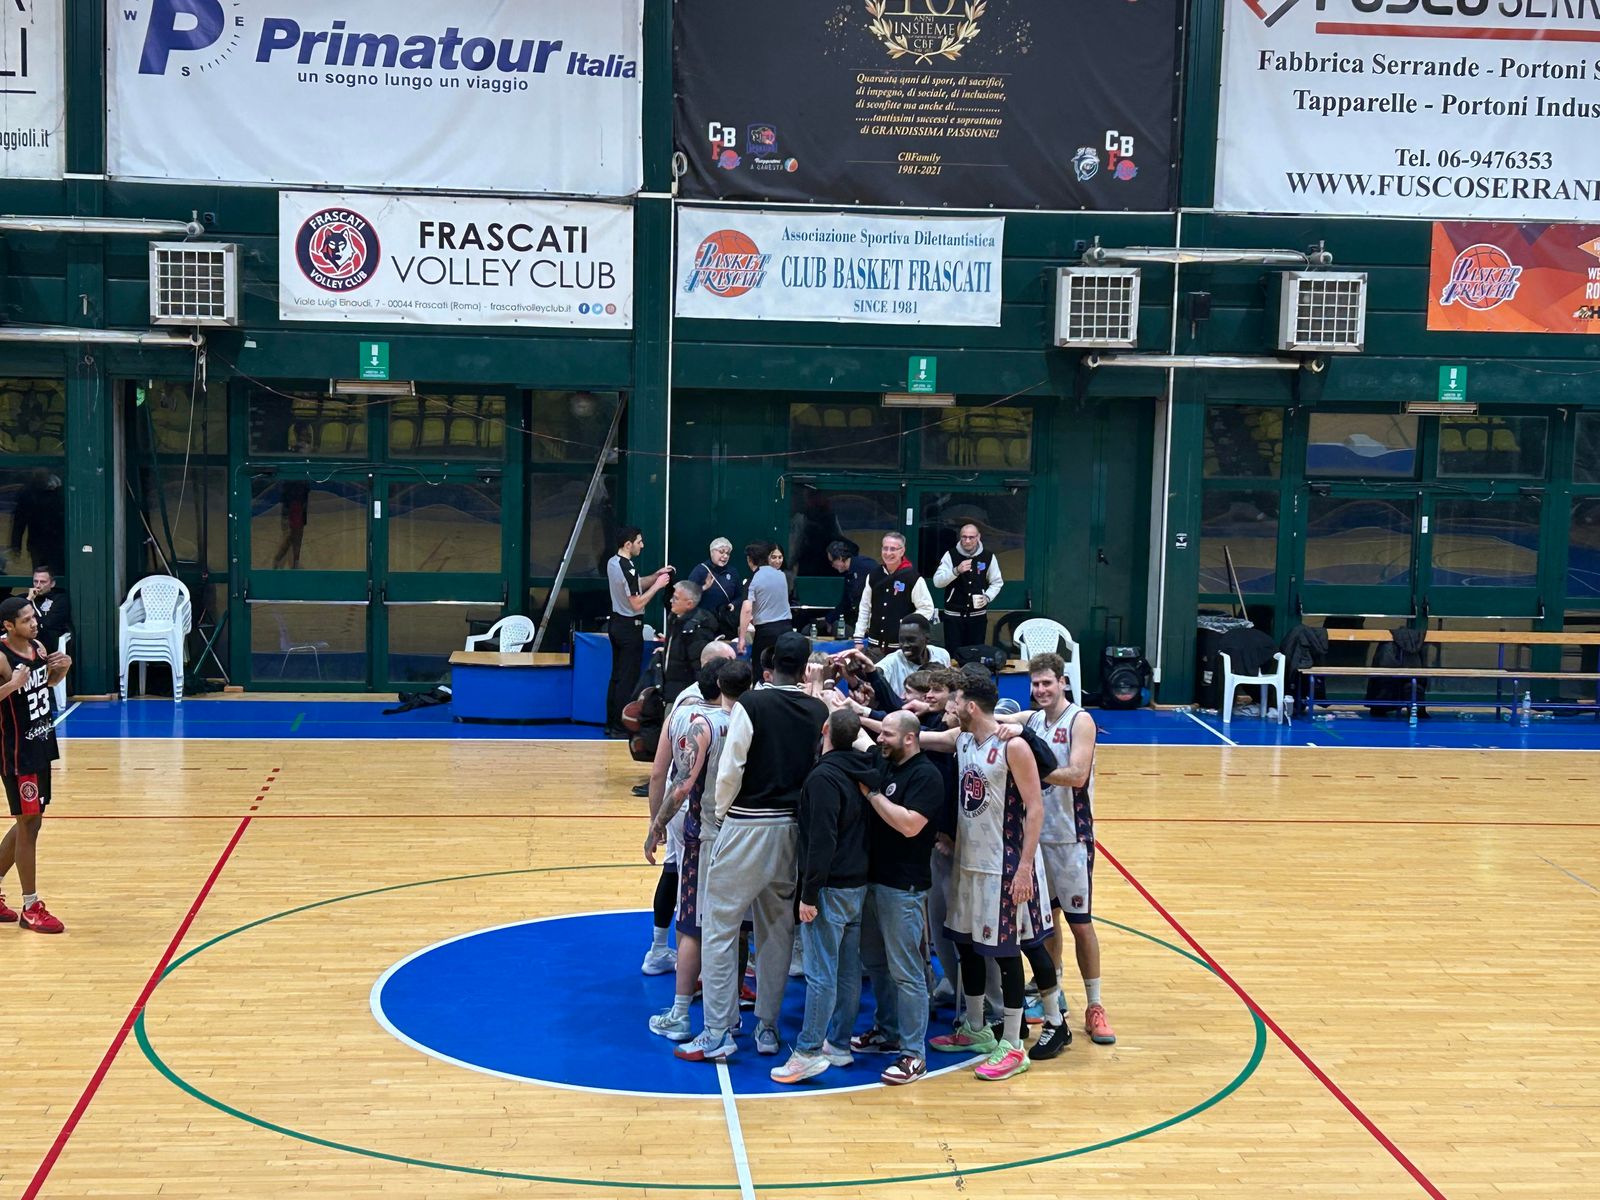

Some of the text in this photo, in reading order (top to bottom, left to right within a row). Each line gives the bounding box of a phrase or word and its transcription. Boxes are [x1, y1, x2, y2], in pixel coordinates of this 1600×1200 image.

[123, 10, 137, 21] W
[235, 16, 244, 27] E
[894, 22, 955, 36] INSIEME
[255, 17, 637, 79] Primatour Italia
[913, 39, 934, 49] CBF
[181, 66, 190, 77] S
[1257, 50, 1364, 73] Fabbrica
[1371, 53, 1480, 77] Serrande
[1499, 57, 1586, 80] Portoni
[297, 72, 528, 93] un sogno lungo un viaggio
[856, 73, 1005, 88] Quaranta anni di sport, di sacrifici,
[856, 86, 1006, 102] di impegno, di sociale, di inclusione,
[1293, 89, 1417, 117] Tapparelle
[1441, 94, 1528, 116] Portoni
[856, 99, 866, 108] di
[866, 100, 902, 111] sconfitte
[919, 101, 943, 110] anche
[916, 115, 949, 124] successi
[956, 117, 1003, 126] soprattutto
[860, 125, 1000, 139] di GRANDISSIMA PASSIONE!
[898, 152, 941, 164] CBFamily
[1395, 148, 1553, 169] Tel. 06-9476353
[898, 165, 942, 175] 1981-2021
[309, 211, 366, 230] FRASCATI
[419, 221, 587, 253] FRASCATI
[782, 225, 995, 248] Associazione Sportiva Dilettantistica
[697, 242, 772, 271] BASKET
[309, 269, 368, 289] VOLLEY CLUB
[391, 255, 616, 289] VOLLEY CLUB
[781, 255, 992, 293] CLUB BASKET FRASCATI
[1455, 257, 1522, 283] BASKET
[294, 297, 315, 306] Viale
[318, 298, 337, 308] Luigi
[339, 298, 373, 308] Einaudi,
[388, 300, 413, 308] 00044
[414, 300, 449, 309] Frascati
[450, 302, 481, 311] (Roma)
[490, 302, 572, 314] frascativolleyclub.it
[853, 300, 918, 314] SINCE 1981
[27, 688, 51, 720] 23
